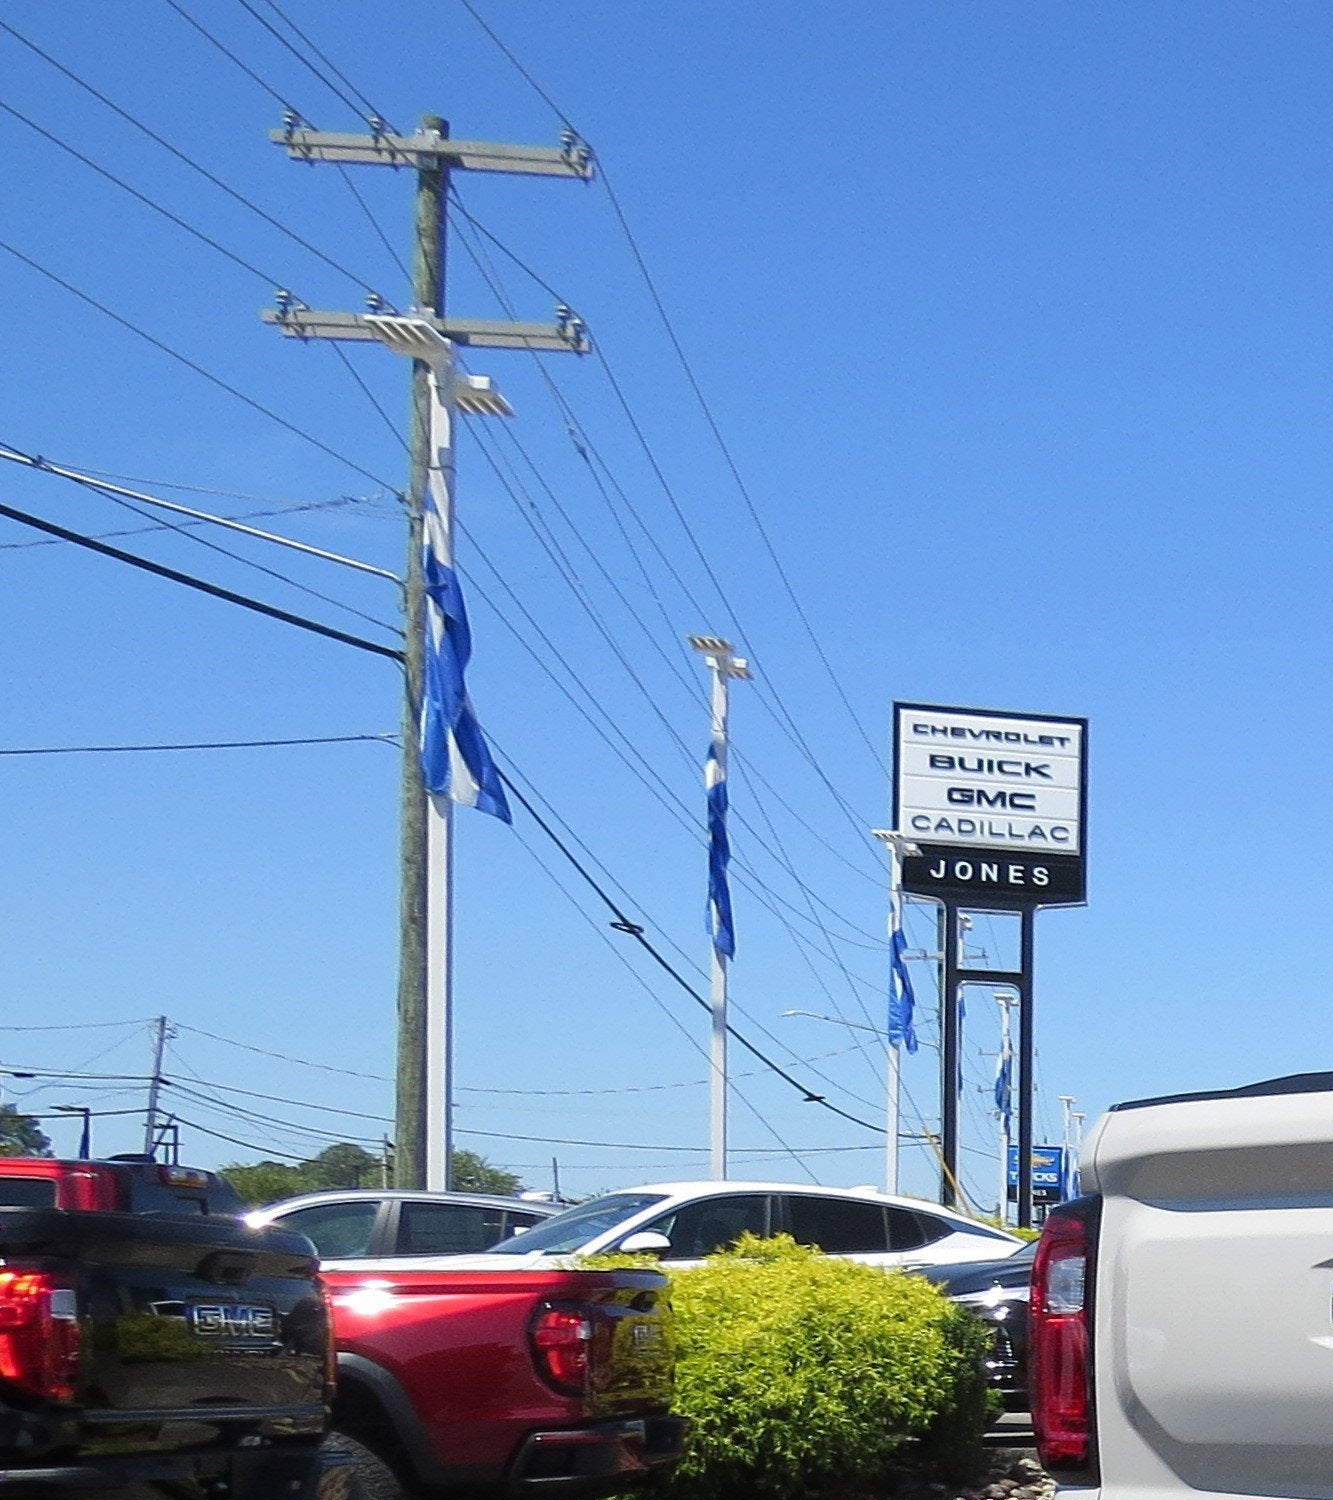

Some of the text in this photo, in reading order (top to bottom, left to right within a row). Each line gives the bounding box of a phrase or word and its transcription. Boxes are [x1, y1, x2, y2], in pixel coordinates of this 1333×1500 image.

[912, 723, 1070, 748] CHEVROLET
[929, 754, 1053, 779] BUICK
[947, 787, 1036, 811] GMC
[911, 815, 1070, 843] CADILLAC
[929, 860, 1050, 886] JONES
[193, 1305, 275, 1337] GMC
